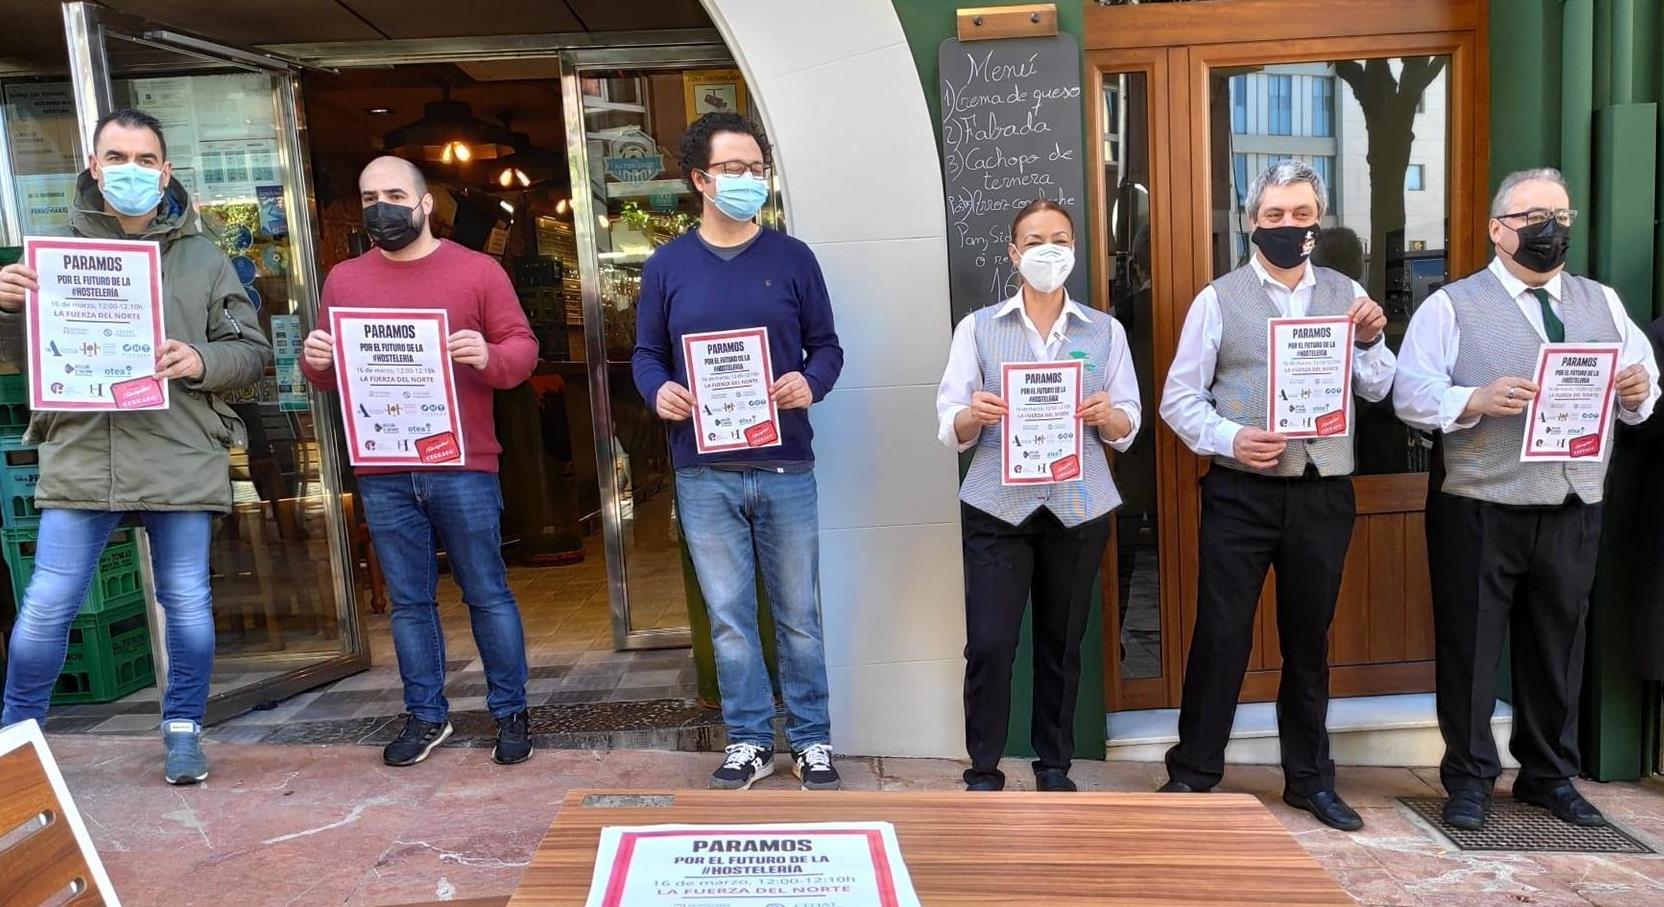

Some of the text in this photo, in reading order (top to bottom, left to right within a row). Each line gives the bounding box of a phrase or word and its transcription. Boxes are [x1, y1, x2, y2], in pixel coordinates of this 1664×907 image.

[967, 49, 1040, 84] Menú
[1006, 84, 1028, 104] de
[1032, 86, 1080, 116] queso
[960, 112, 1051, 144] Fabada
[966, 147, 1040, 174] Cachopo
[1048, 142, 1072, 160] de
[984, 172, 1054, 190] ternera
[63, 255, 122, 272] PARAMOS
[58, 275, 130, 286] POR EL FUTURO DE LA
[72, 287, 119, 298] #HOSTELERÍA
[364, 324, 416, 339] PARAMOS
[1293, 327, 1331, 338] PARAMOS
[360, 343, 423, 352] POR EL FUTURO DE LA
[707, 341, 744, 354] PARAMOS
[373, 354, 414, 363] #HOSTELERÍA
[1562, 357, 1597, 367] PARAMOS
[1025, 372, 1062, 384] PARAMOS
[692, 840, 813, 853] PARAMOS
[674, 855, 830, 865] POR EL FUTURO DE LA
[699, 879, 752, 887] marzo,
[758, 876, 855, 885] 12:00-12:10h
[793, 885, 851, 893] NORTE
